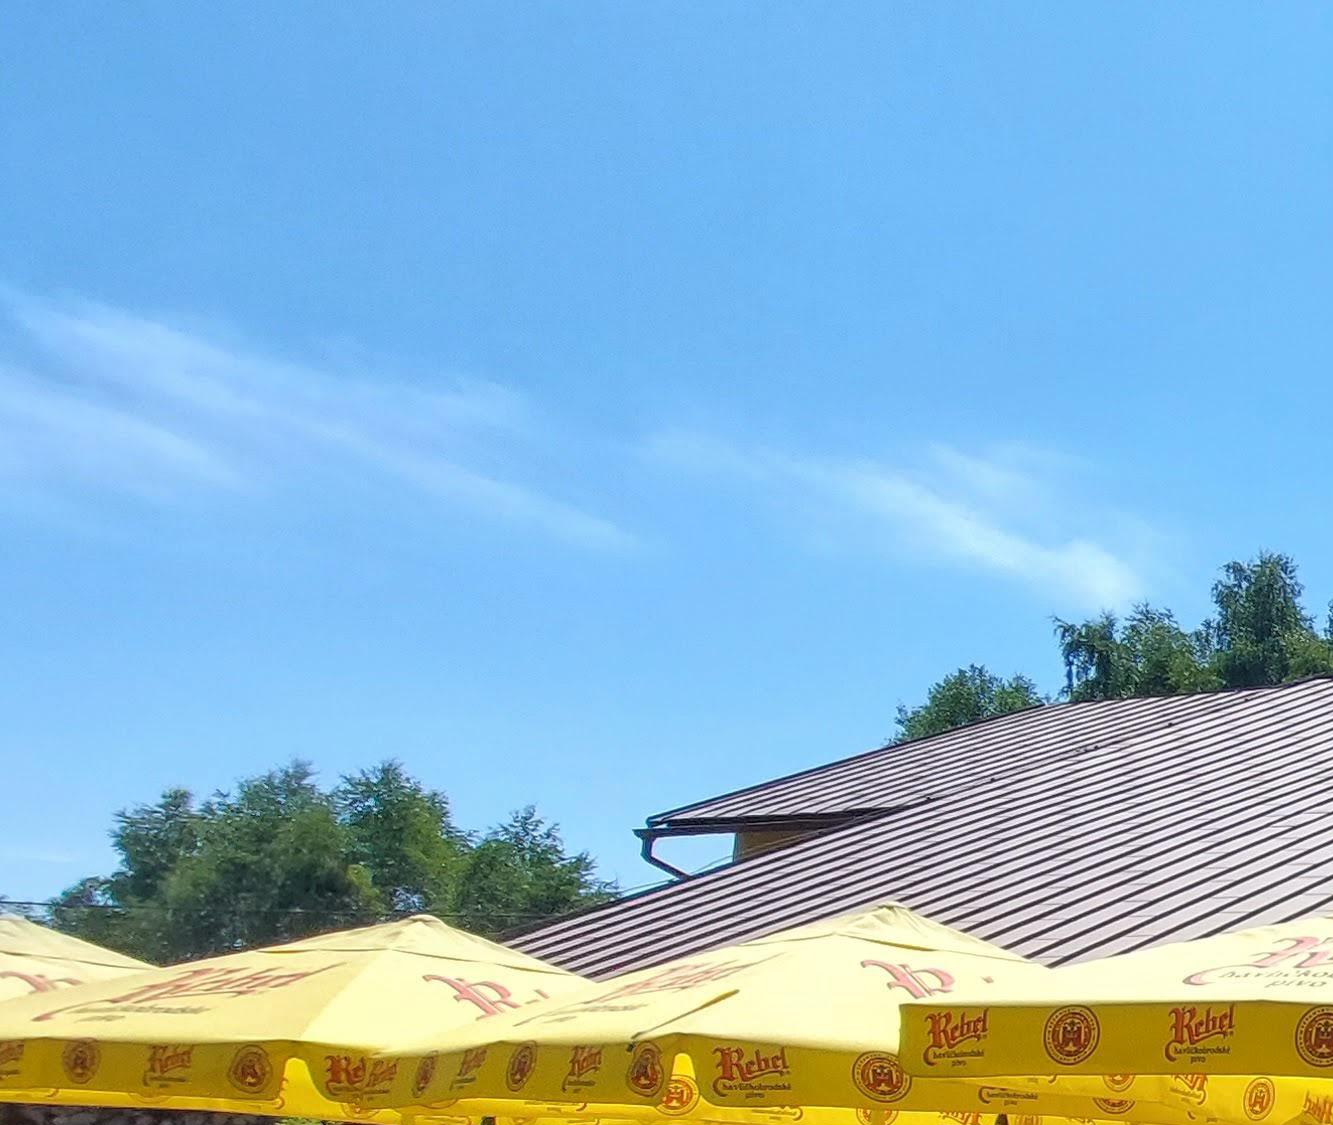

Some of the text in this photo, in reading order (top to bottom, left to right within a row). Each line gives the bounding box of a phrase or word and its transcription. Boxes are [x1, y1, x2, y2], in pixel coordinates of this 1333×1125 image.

[924, 1007, 990, 1053] Rebel
[1166, 1003, 1236, 1050] Rebel
[712, 1046, 790, 1086] Rebel
